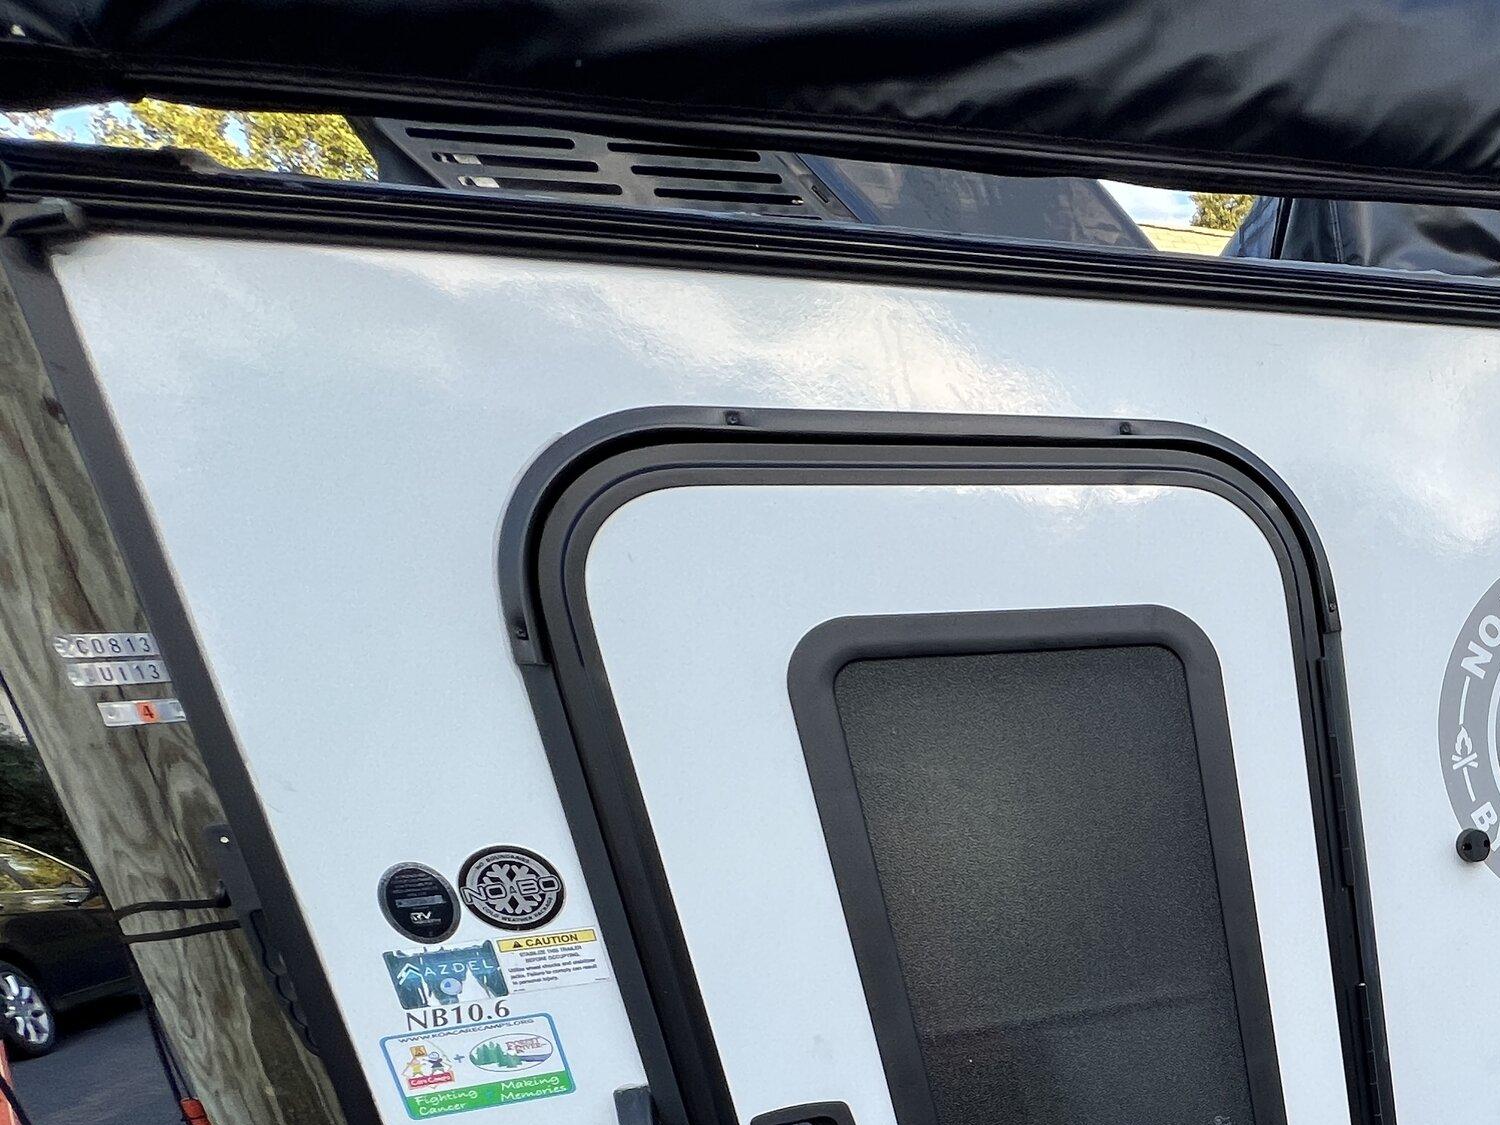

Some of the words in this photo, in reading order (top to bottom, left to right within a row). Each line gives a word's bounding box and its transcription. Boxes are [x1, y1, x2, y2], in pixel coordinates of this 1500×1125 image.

[143, 705, 154, 719] 4
[525, 934, 579, 947] CAUTION
[424, 960, 493, 977] AZDEL
[406, 1000, 510, 1031] NB10.6
[500, 1075, 560, 1091] Making
[414, 1091, 478, 1107] Fighting
[500, 1085, 567, 1102] Memories
[419, 1103, 466, 1115] Cancer
